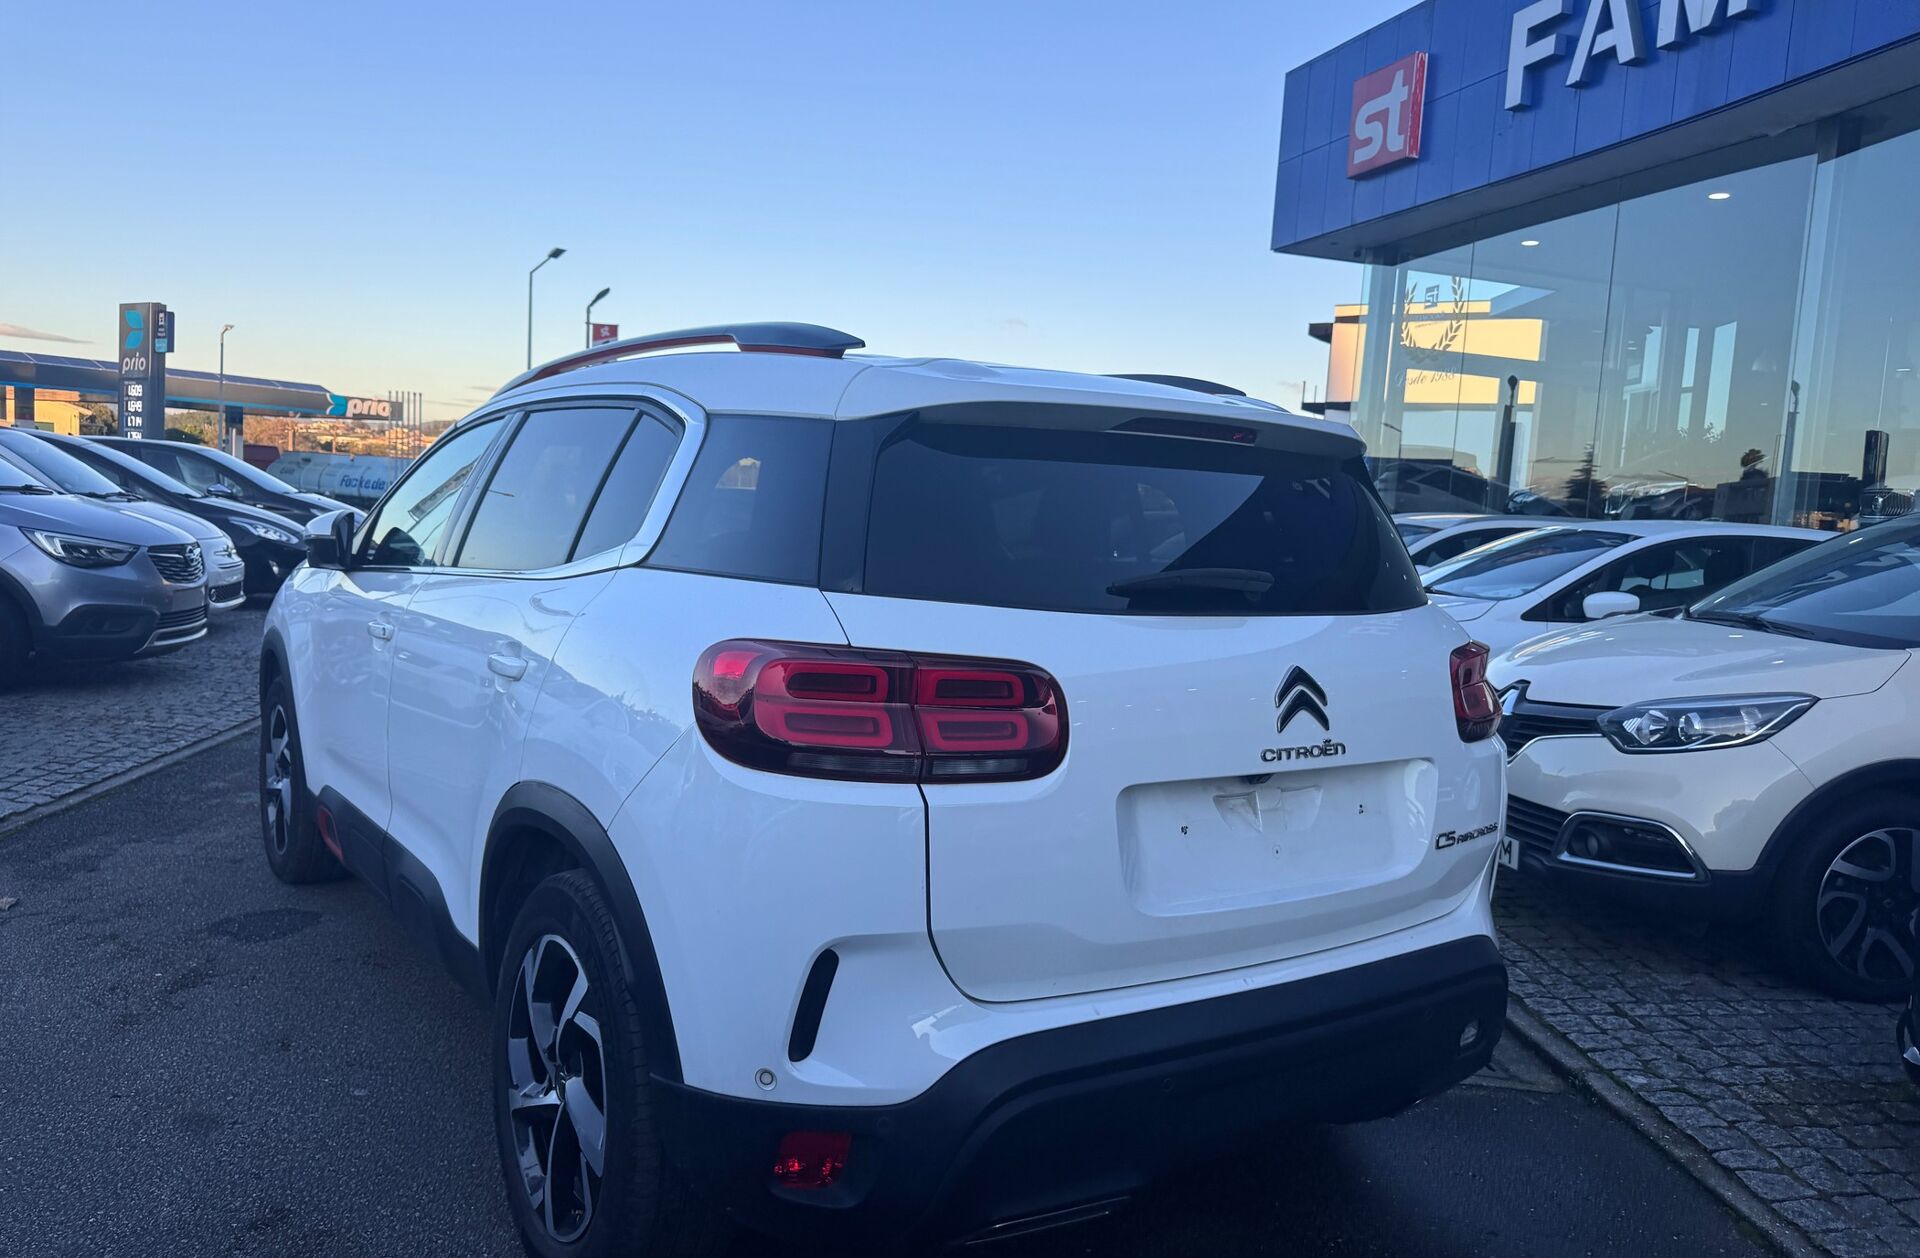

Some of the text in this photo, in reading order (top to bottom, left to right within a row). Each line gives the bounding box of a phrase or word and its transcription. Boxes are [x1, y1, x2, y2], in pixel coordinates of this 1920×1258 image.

[122, 351, 146, 374] prio
[345, 397, 391, 417] prio
[1435, 822, 1499, 850] C5 AIRCROSS
